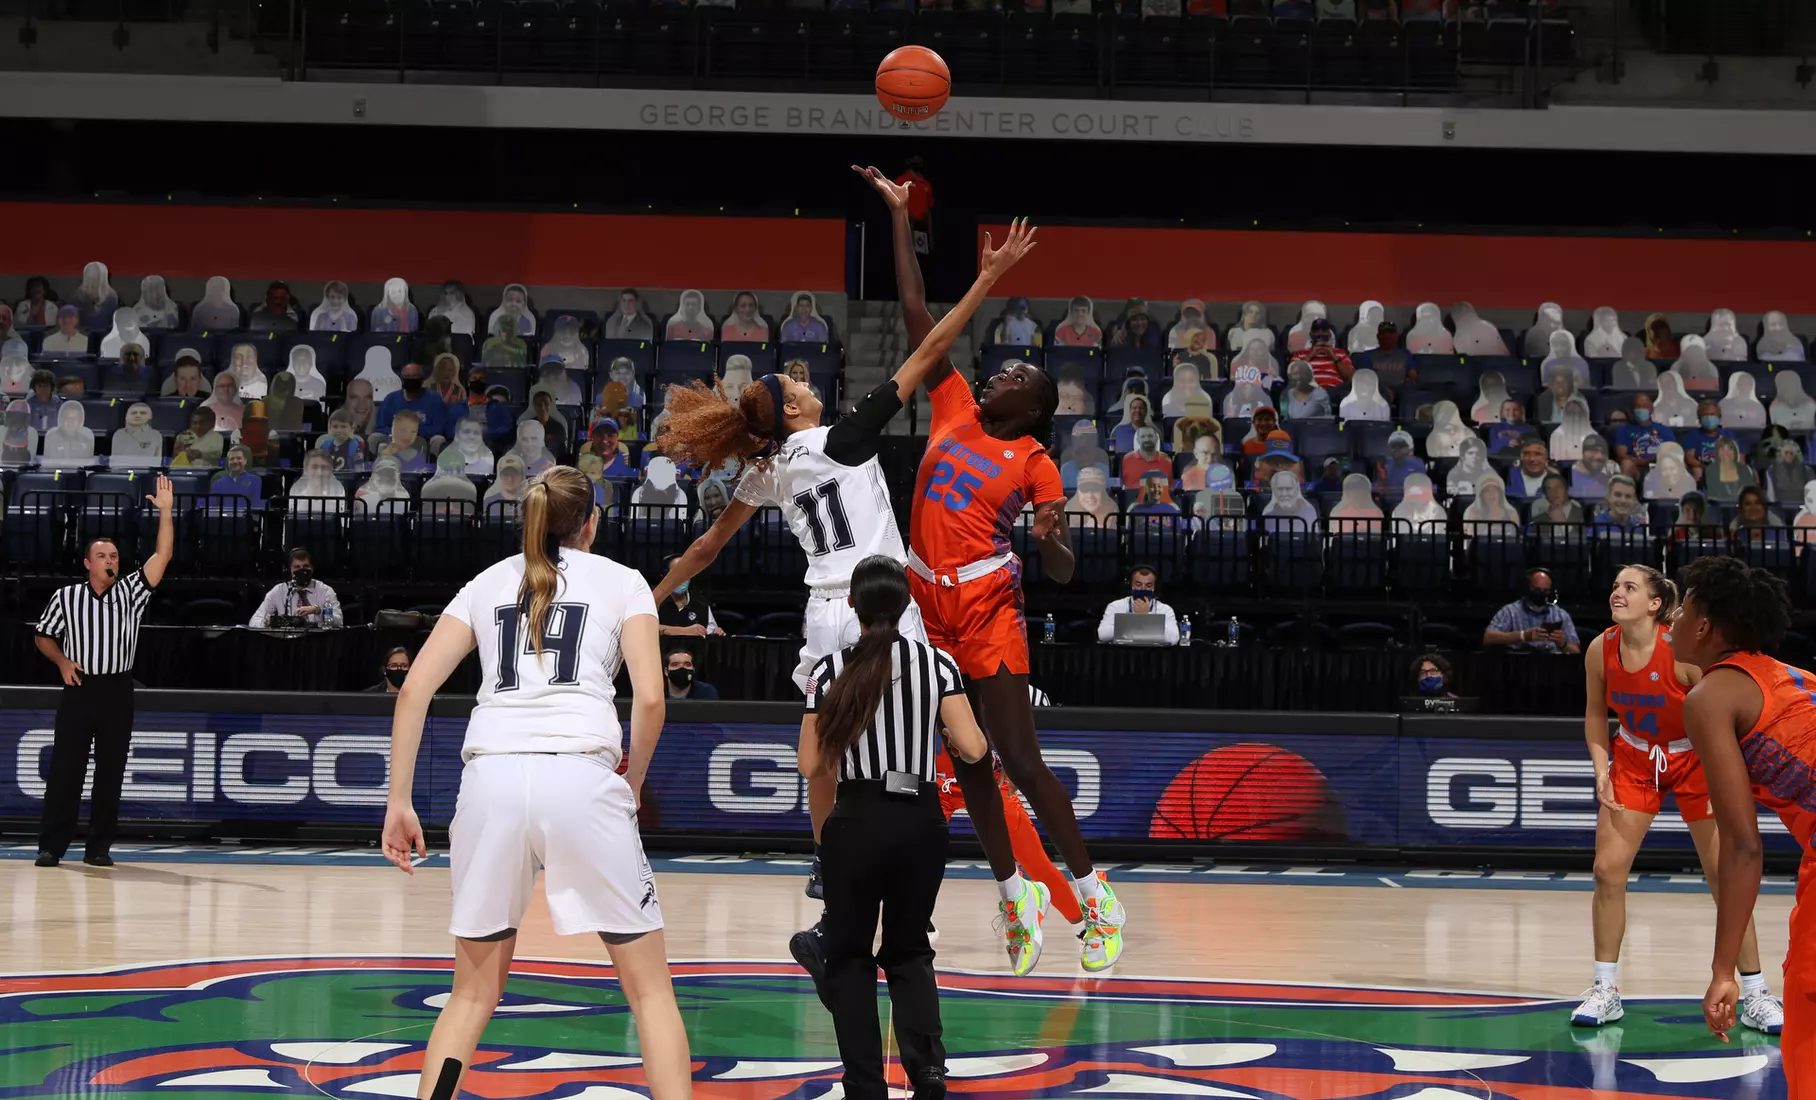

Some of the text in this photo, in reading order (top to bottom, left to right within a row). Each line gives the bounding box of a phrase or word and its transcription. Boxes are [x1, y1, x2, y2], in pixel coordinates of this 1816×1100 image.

[640, 104, 771, 127] GEORGE
[786, 107, 897, 130] BRAND
[1051, 113, 1159, 135] COURT
[1174, 116, 1255, 138] CLUB
[938, 438, 1003, 478] GATORS
[924, 461, 984, 511] 25
[793, 478, 855, 557] 11
[494, 602, 589, 693] 14
[1624, 710, 1660, 737] 14
